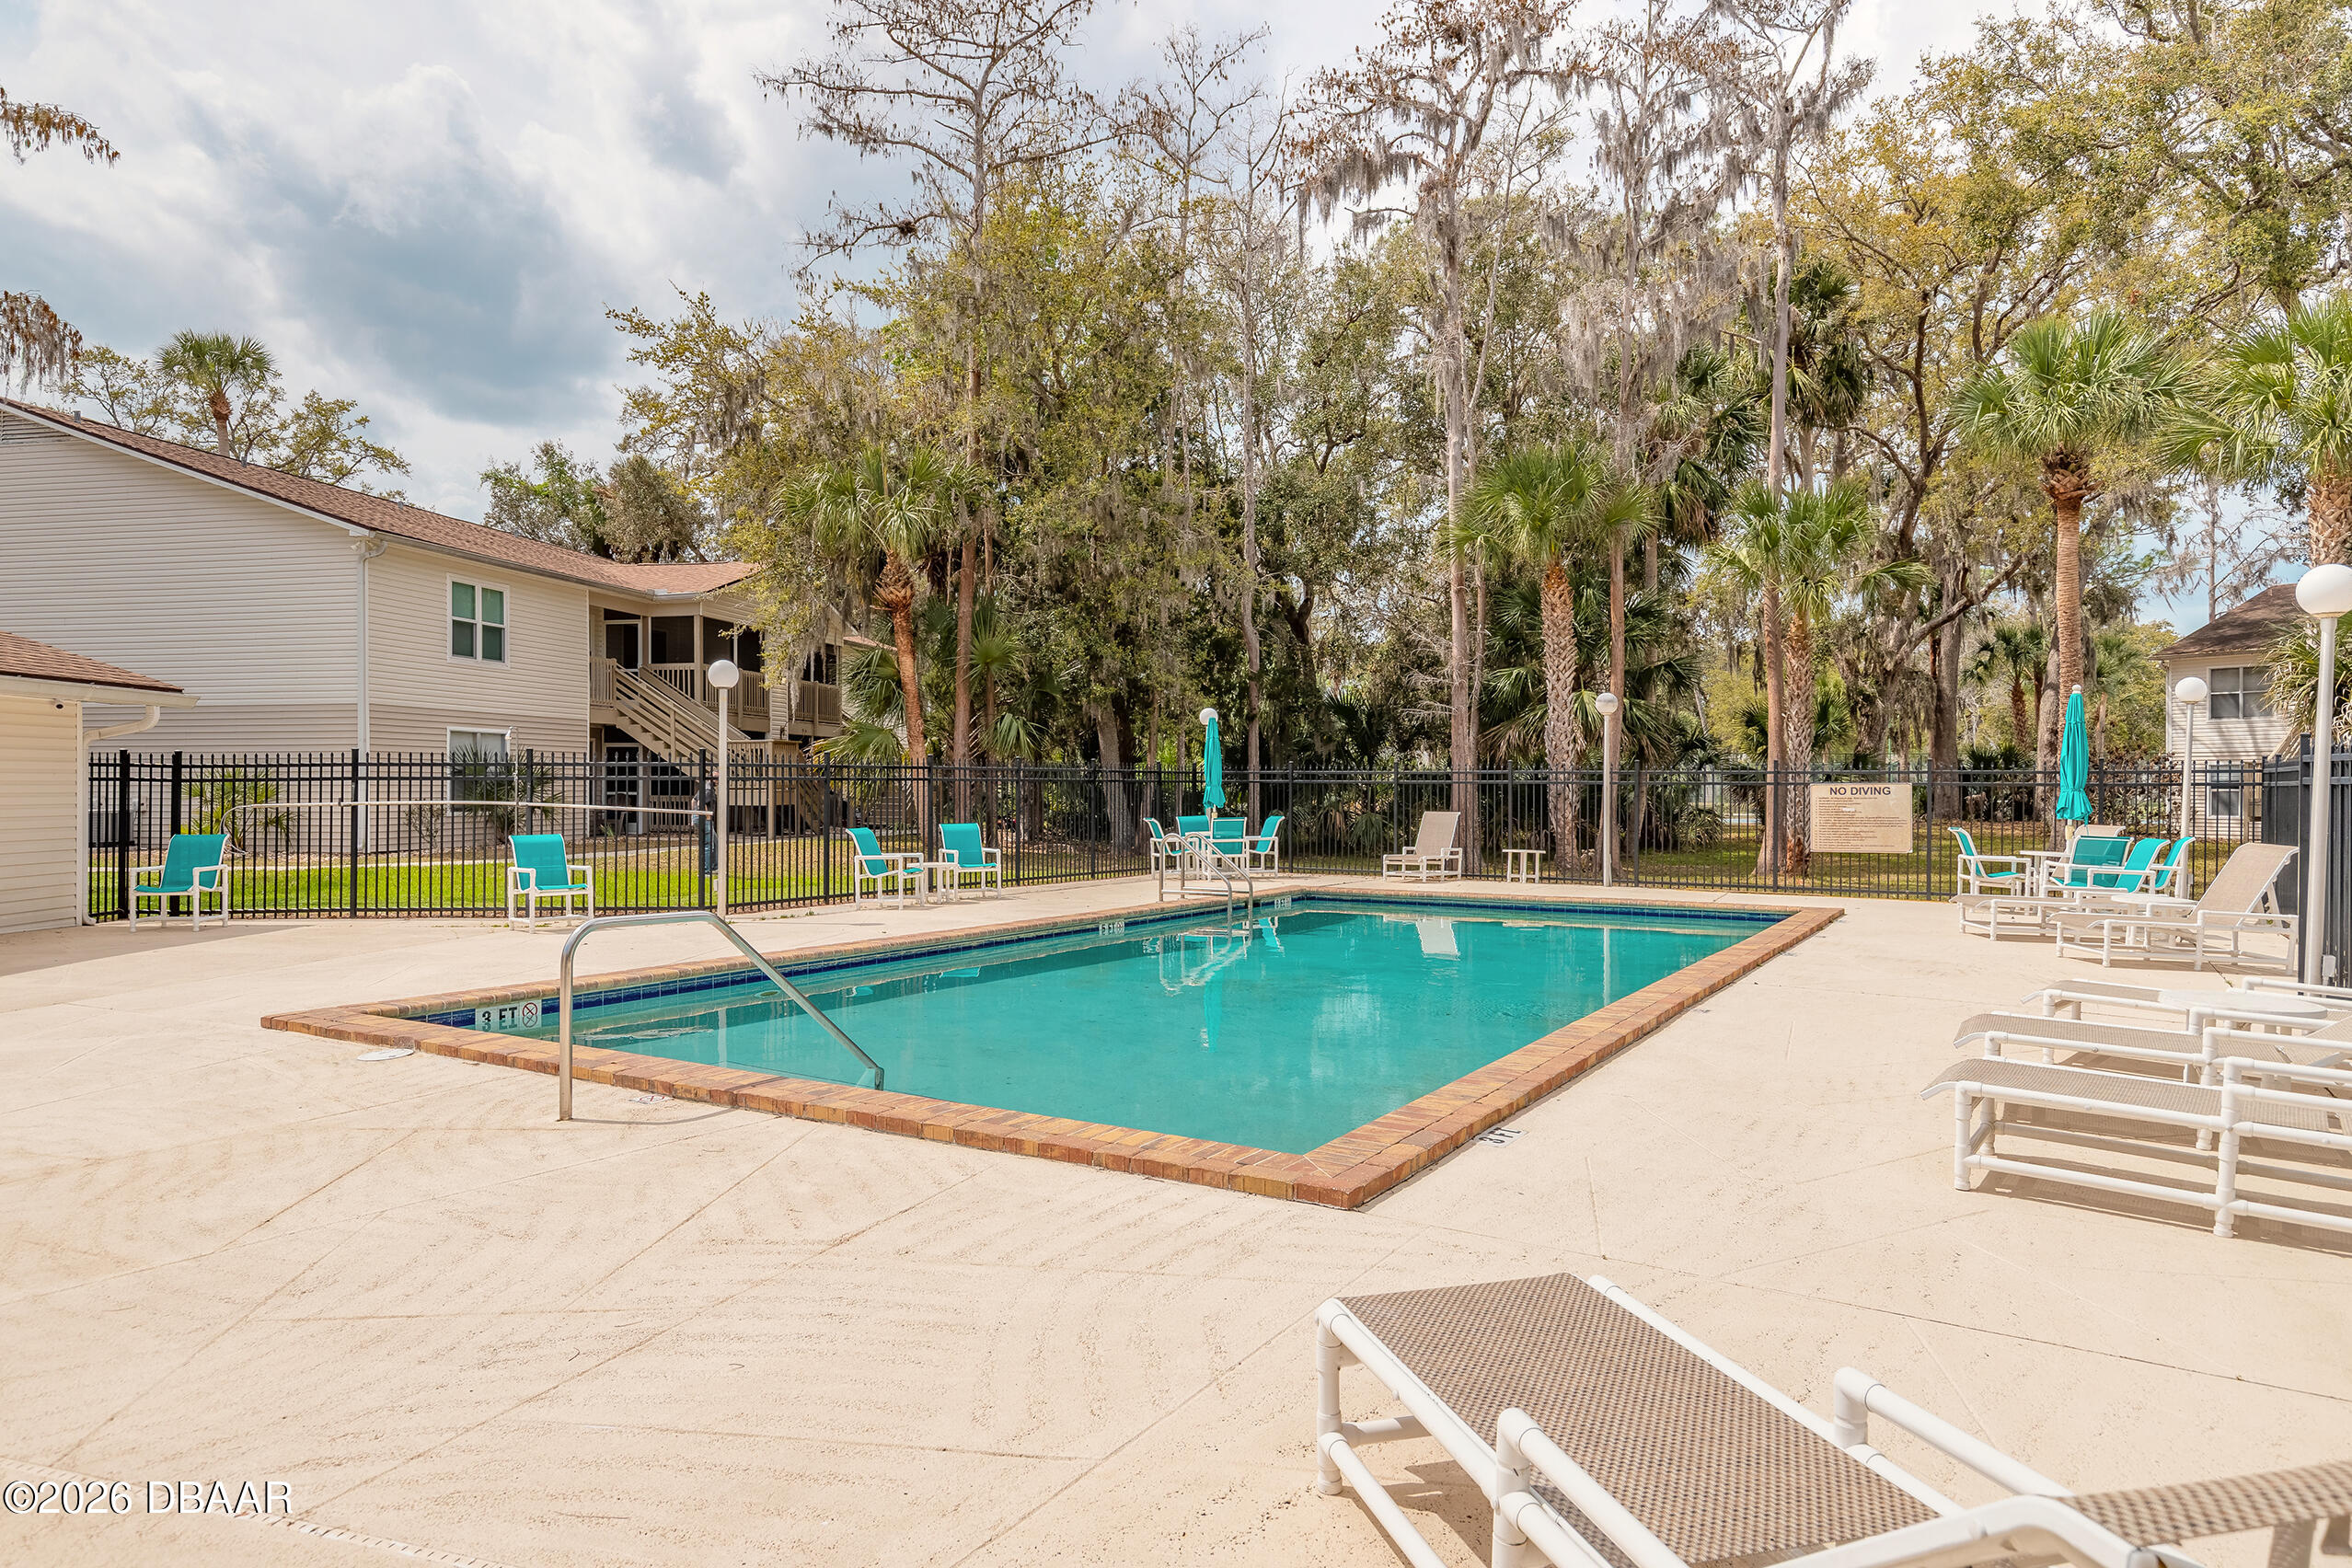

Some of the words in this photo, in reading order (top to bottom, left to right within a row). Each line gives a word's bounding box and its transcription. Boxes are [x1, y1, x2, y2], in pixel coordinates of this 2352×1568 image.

[1829, 787, 1847, 796] NO
[1850, 787, 1891, 796] DIVING
[1487, 1126, 1522, 1139] FT
